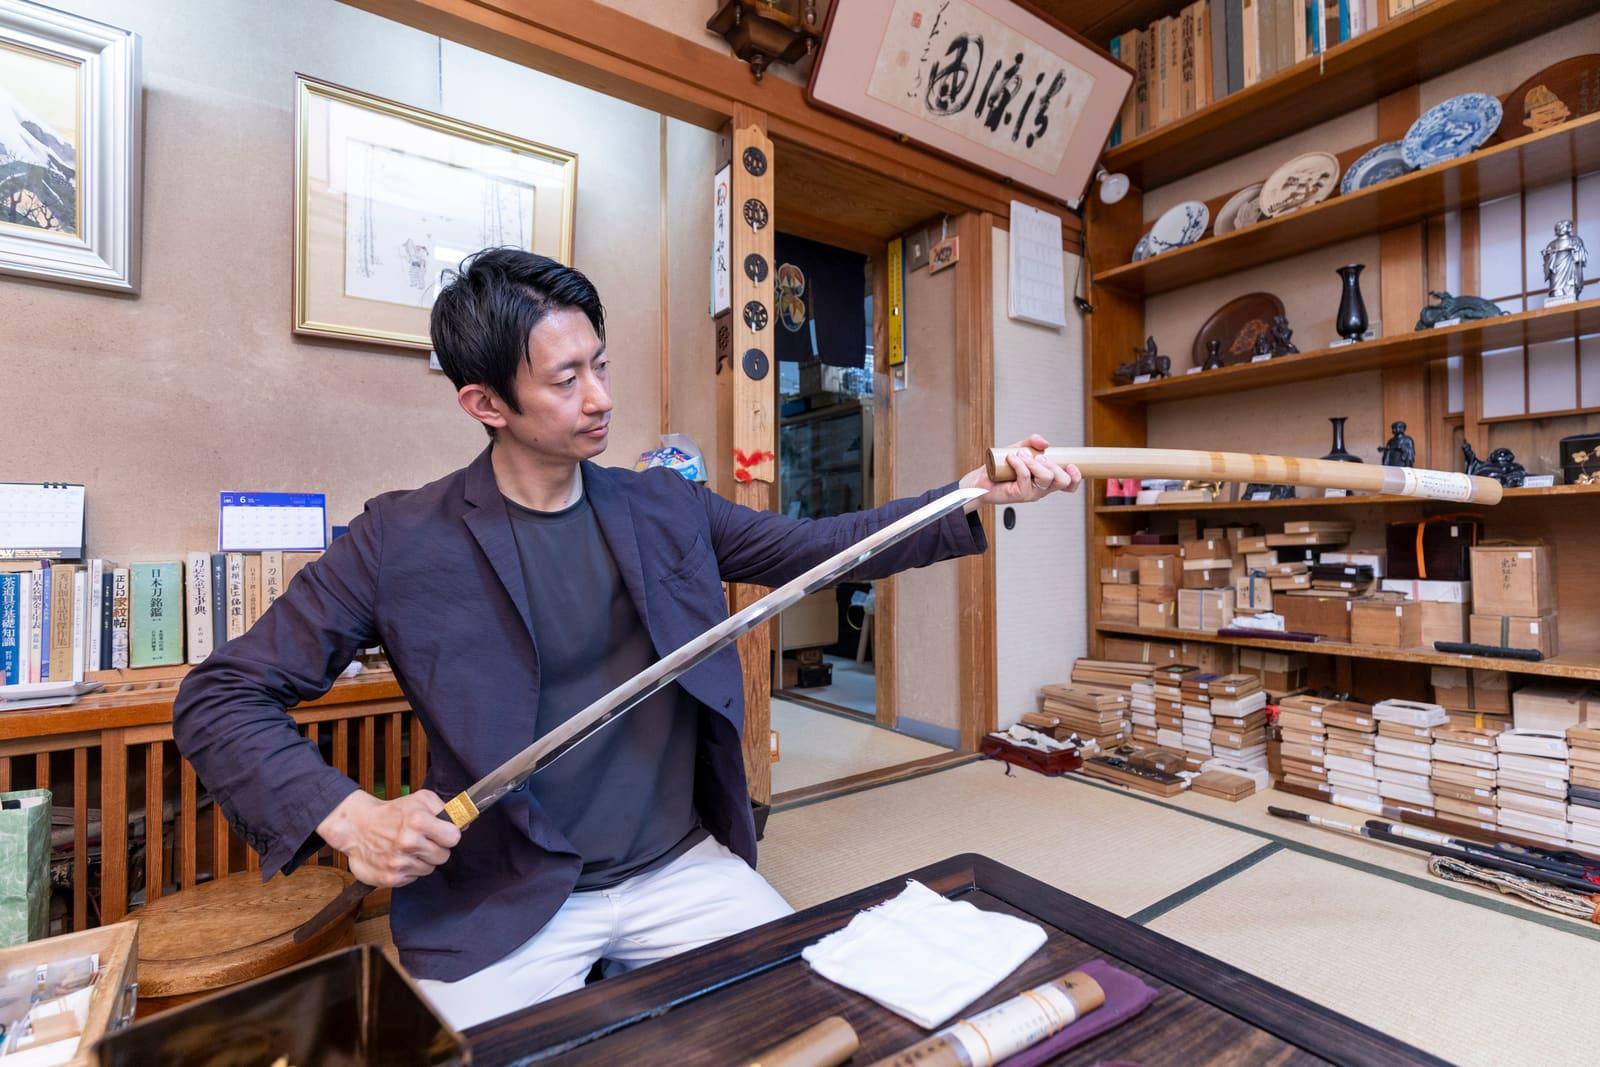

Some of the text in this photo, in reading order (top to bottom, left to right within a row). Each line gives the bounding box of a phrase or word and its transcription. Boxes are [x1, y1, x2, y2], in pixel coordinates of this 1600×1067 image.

[239, 495, 246, 504] 6
[2, 576, 16, 647] 茶道具の基礎知識
[112, 574, 128, 629] 正しい家紋帖
[150, 568, 163, 618] 日本刀銘鑑
